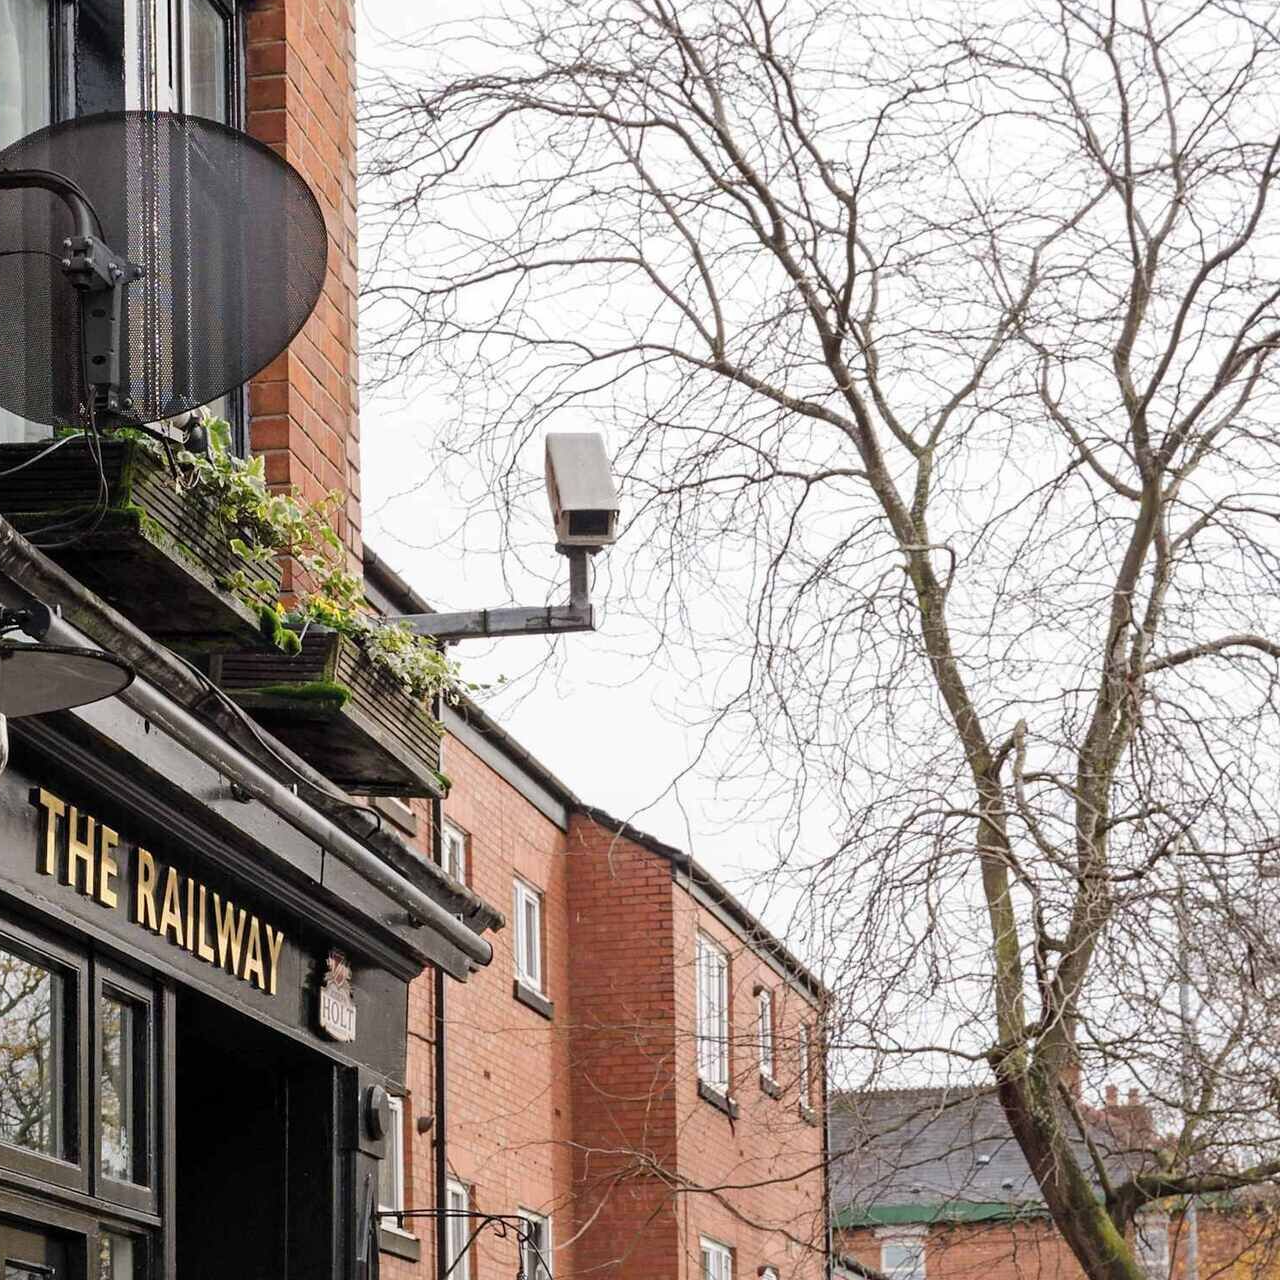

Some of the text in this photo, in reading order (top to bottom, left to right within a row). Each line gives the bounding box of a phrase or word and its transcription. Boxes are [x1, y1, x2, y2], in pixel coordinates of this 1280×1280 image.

[40, 787, 284, 995] THE RAILWAY
[322, 995, 354, 1031] HOLT
